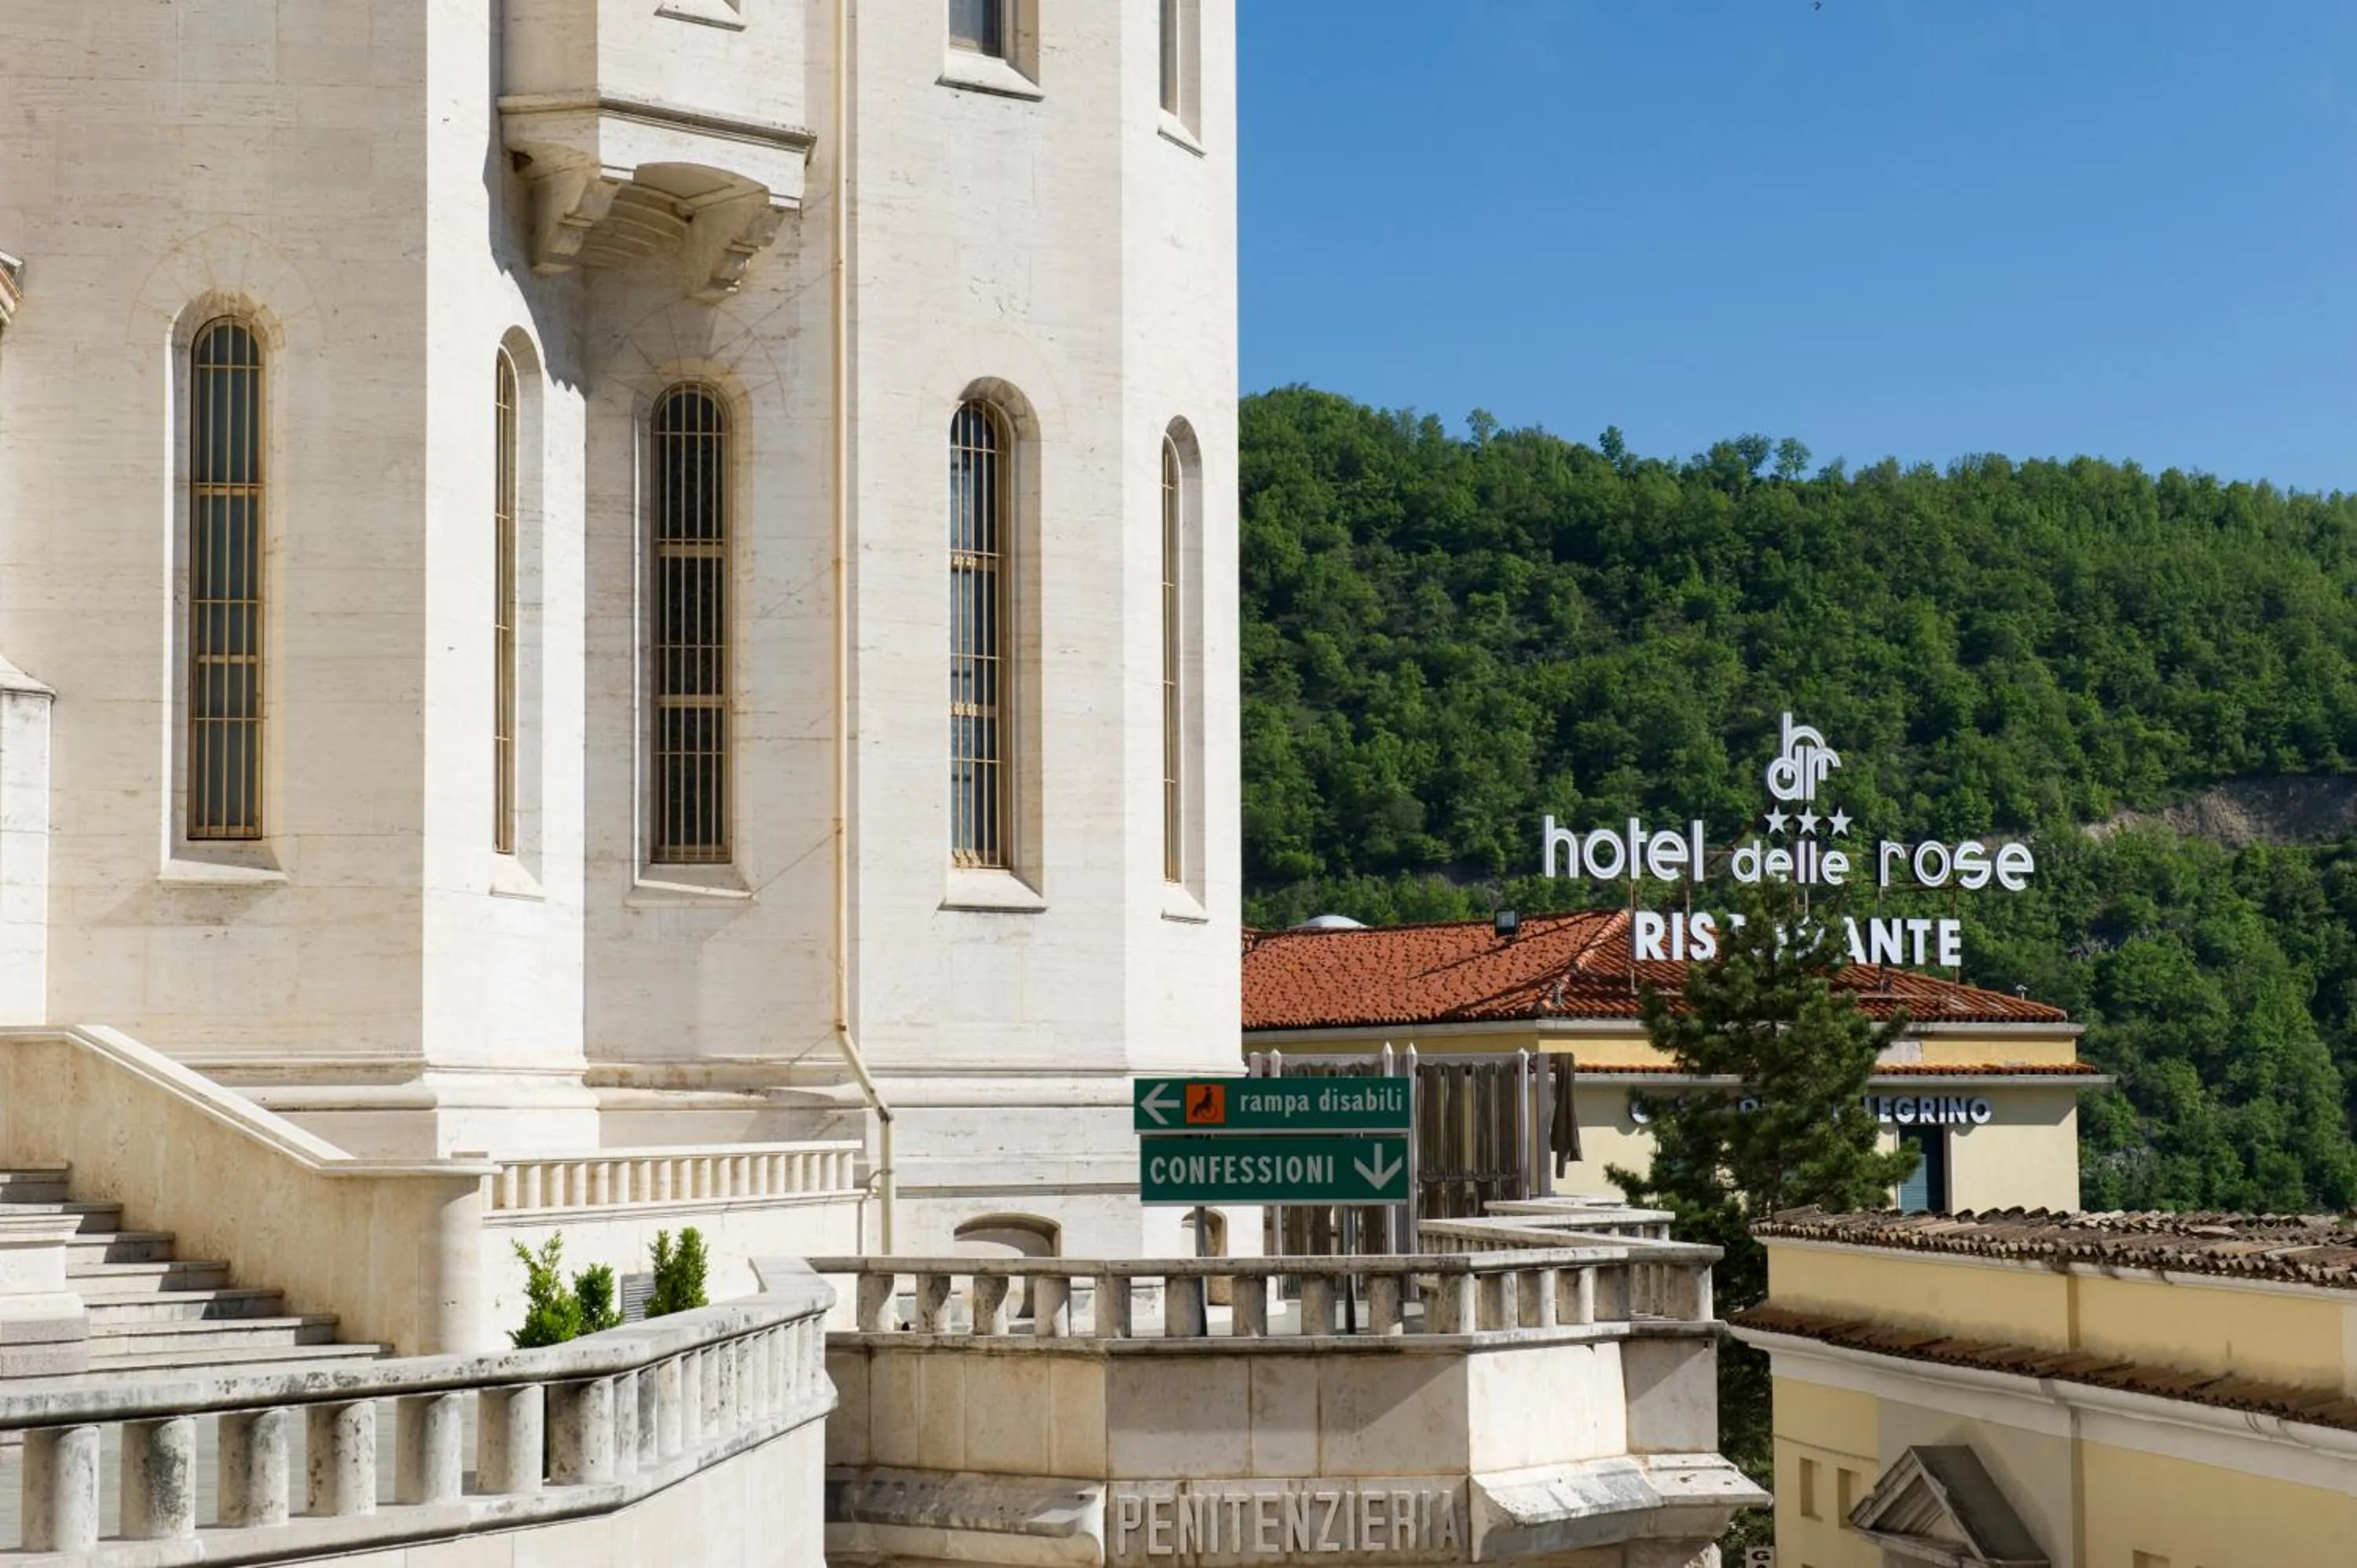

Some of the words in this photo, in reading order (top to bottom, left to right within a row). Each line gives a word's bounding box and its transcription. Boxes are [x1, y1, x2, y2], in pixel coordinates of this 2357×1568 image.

[1542, 815, 1704, 882] hotel
[1732, 841, 1849, 885] delle
[1879, 840, 2035, 890] rose
[1634, 910, 1962, 966] RISANTE
[1240, 1089, 1311, 1118] rampa
[1319, 1087, 1402, 1112] disabili
[1149, 1156, 1334, 1184] CONFESSIONI
[1116, 1491, 1461, 1556] PENITENZIERIA
